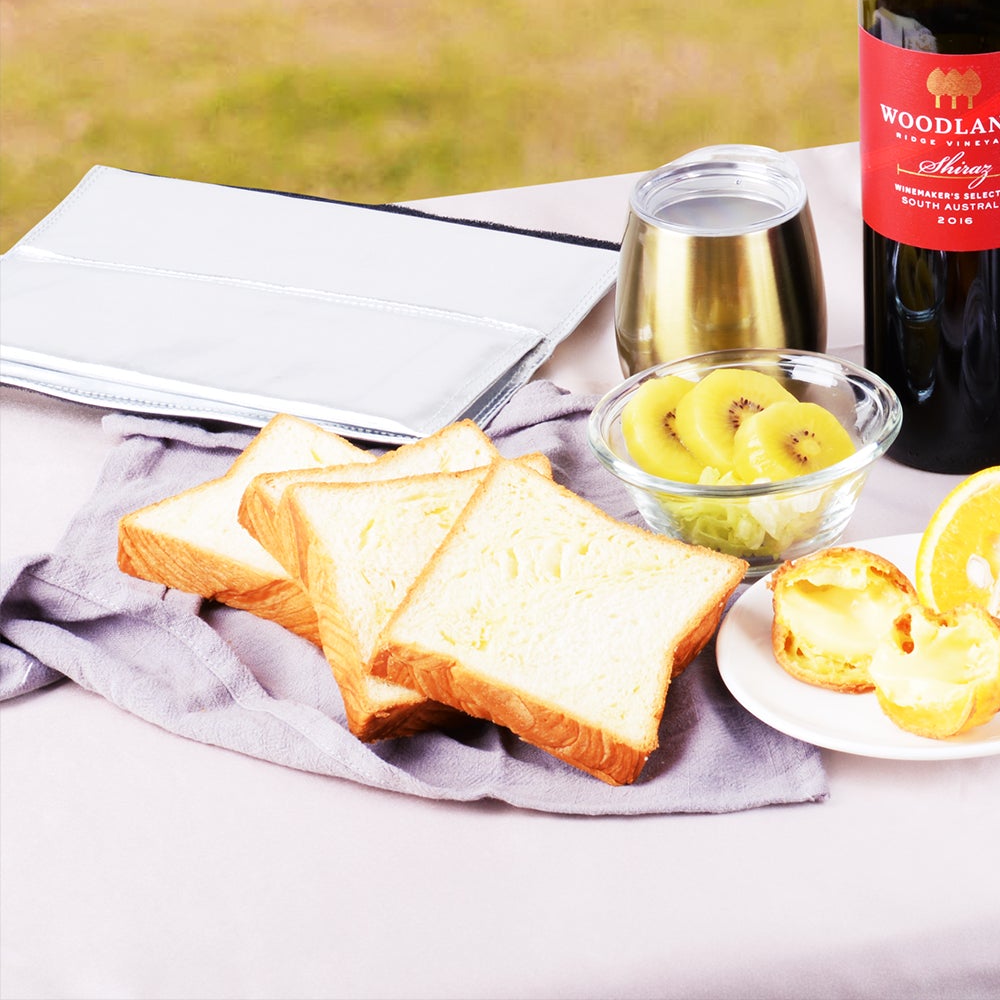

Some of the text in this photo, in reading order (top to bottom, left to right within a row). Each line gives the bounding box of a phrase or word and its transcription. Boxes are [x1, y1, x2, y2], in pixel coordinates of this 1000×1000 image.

[896, 132, 936, 146] RIDGE
[918, 151, 994, 189] Shiraz
[894, 183, 960, 200] WINEMAKER'S
[901, 196, 941, 210] SOUTH
[937, 216, 973, 225] 2016
